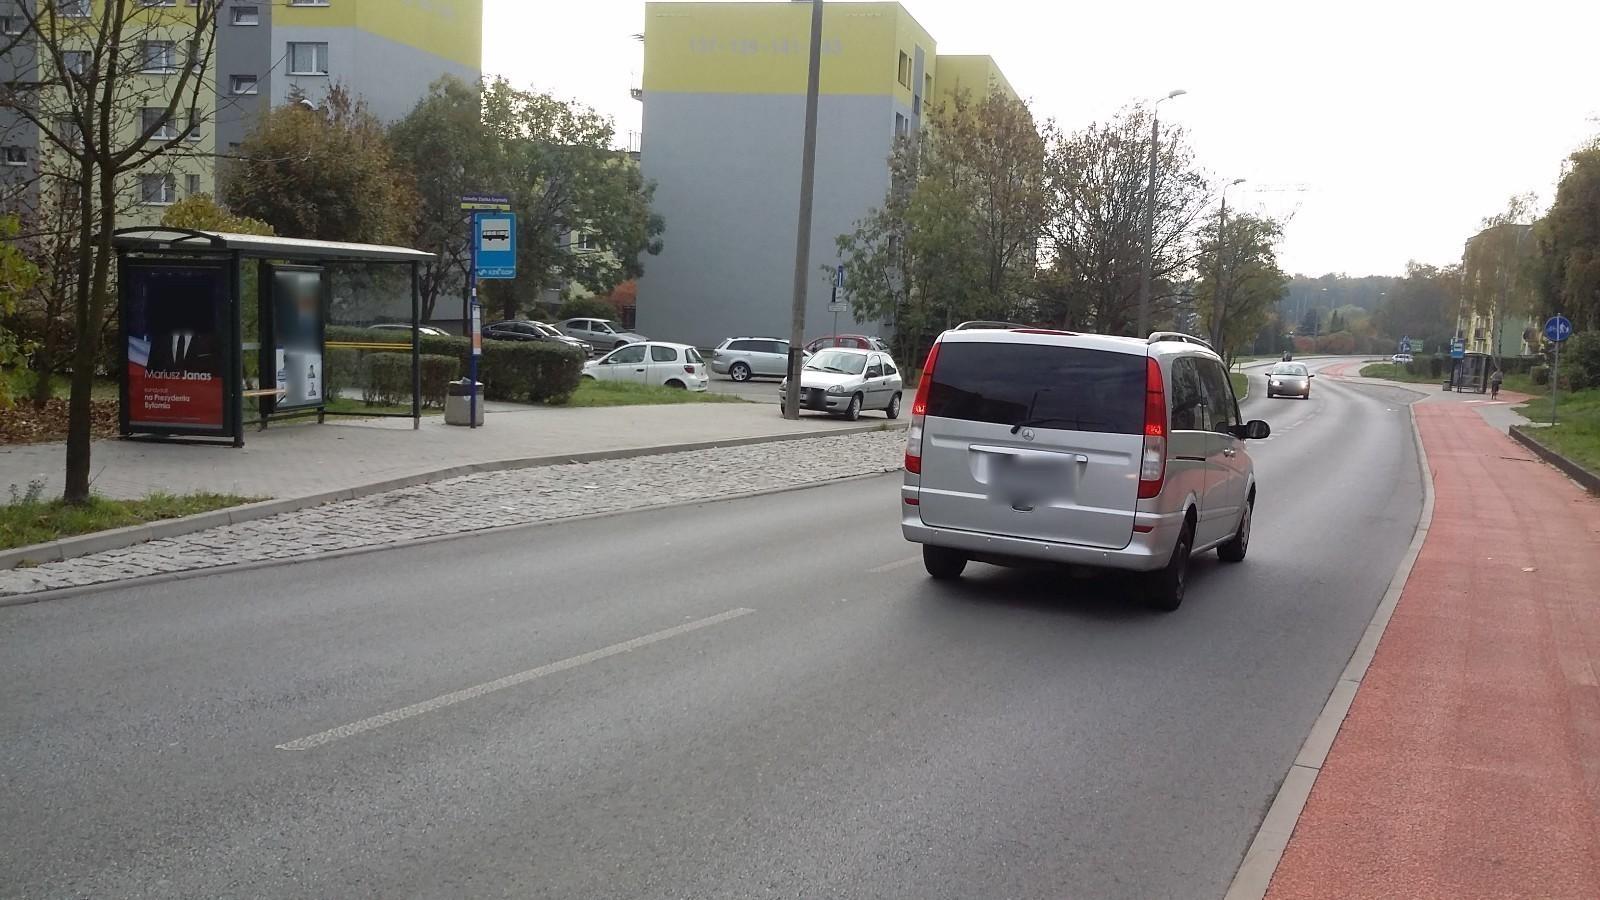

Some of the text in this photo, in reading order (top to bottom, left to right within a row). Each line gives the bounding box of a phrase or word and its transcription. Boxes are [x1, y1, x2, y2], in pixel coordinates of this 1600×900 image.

[144, 369, 212, 381] Mariusz Janas
[154, 393, 190, 403] Prezydenta
[144, 401, 171, 410] Bytomia
